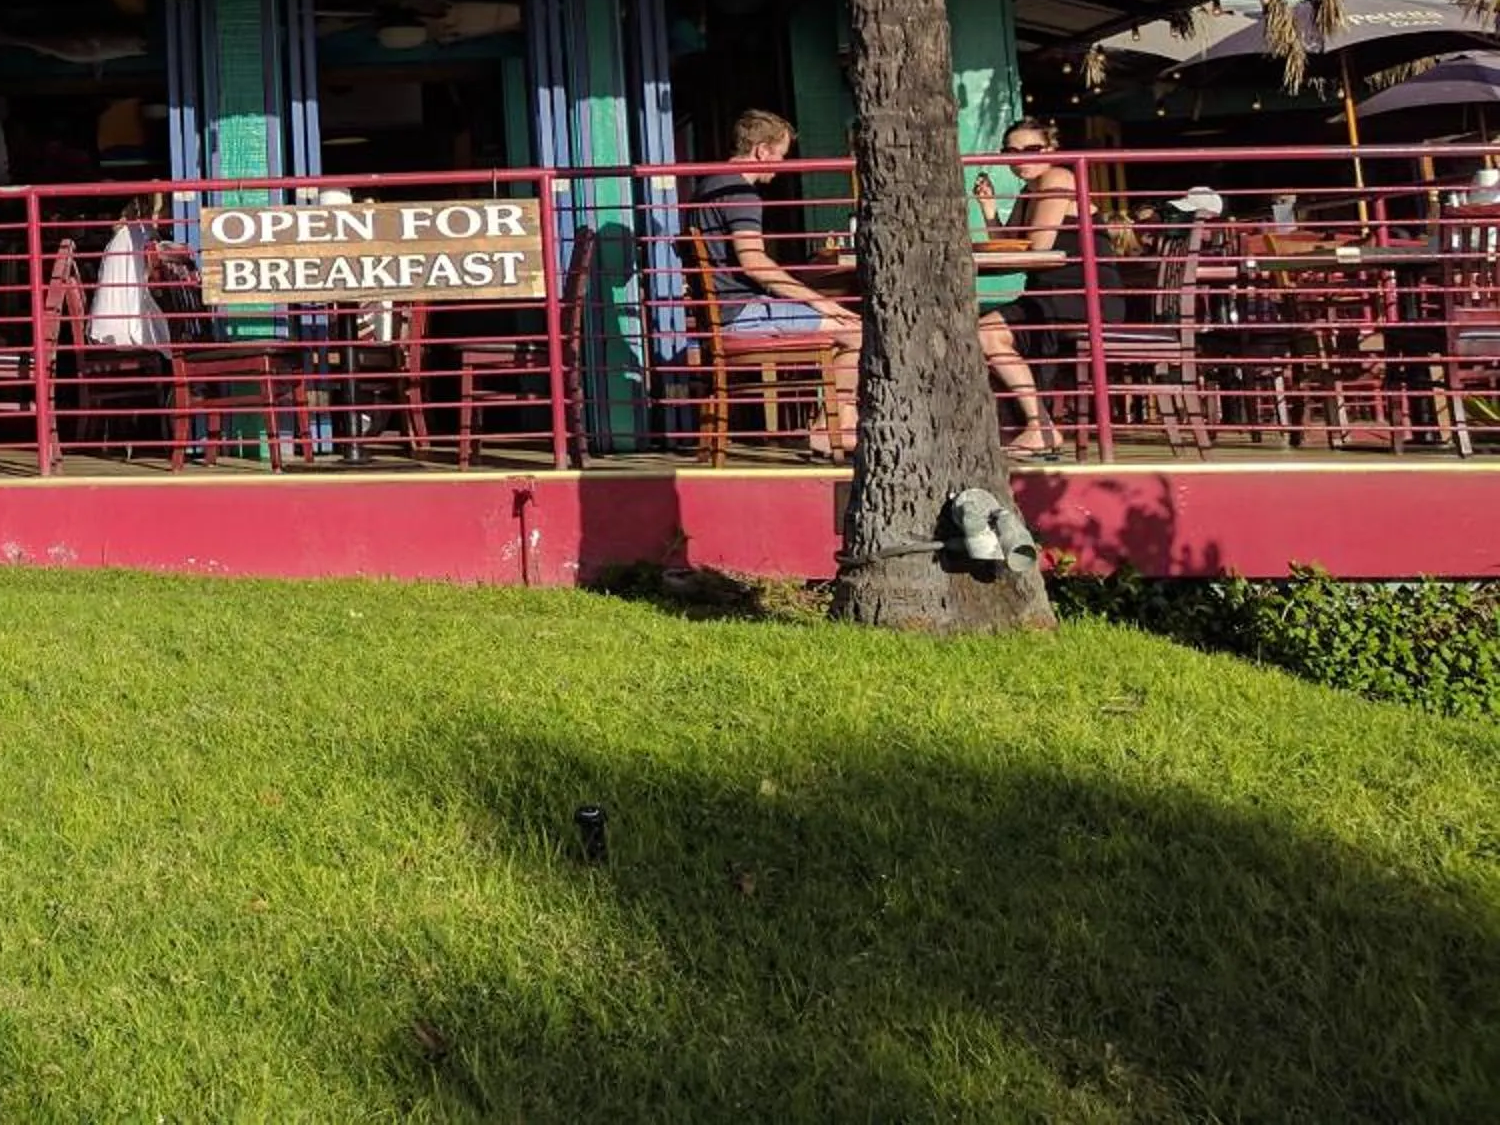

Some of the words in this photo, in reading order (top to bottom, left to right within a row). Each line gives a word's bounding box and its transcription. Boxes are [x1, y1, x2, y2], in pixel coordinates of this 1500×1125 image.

[211, 208, 374, 244] OPEN
[399, 203, 528, 240] FOR
[222, 251, 525, 293] BREAKFAST
